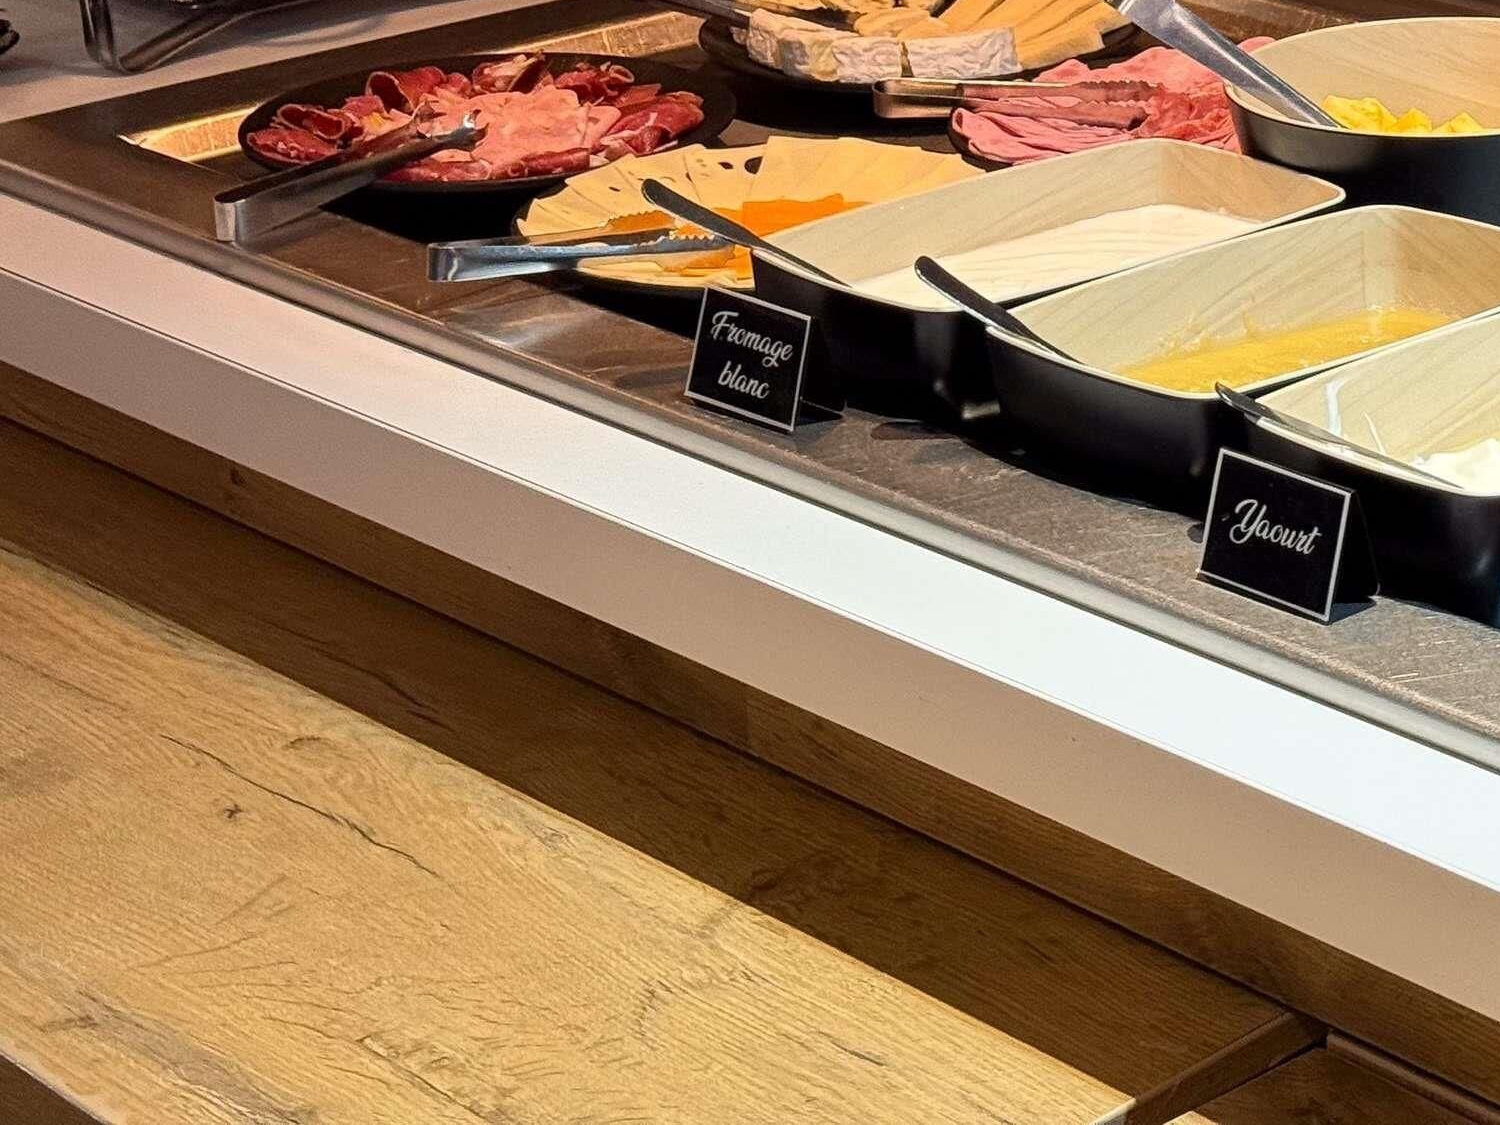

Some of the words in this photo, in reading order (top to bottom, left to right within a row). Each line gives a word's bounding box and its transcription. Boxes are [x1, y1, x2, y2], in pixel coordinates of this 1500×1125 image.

[710, 310, 793, 368] Fromage
[718, 360, 770, 399] blanc
[1229, 499, 1322, 555] Yaourt
